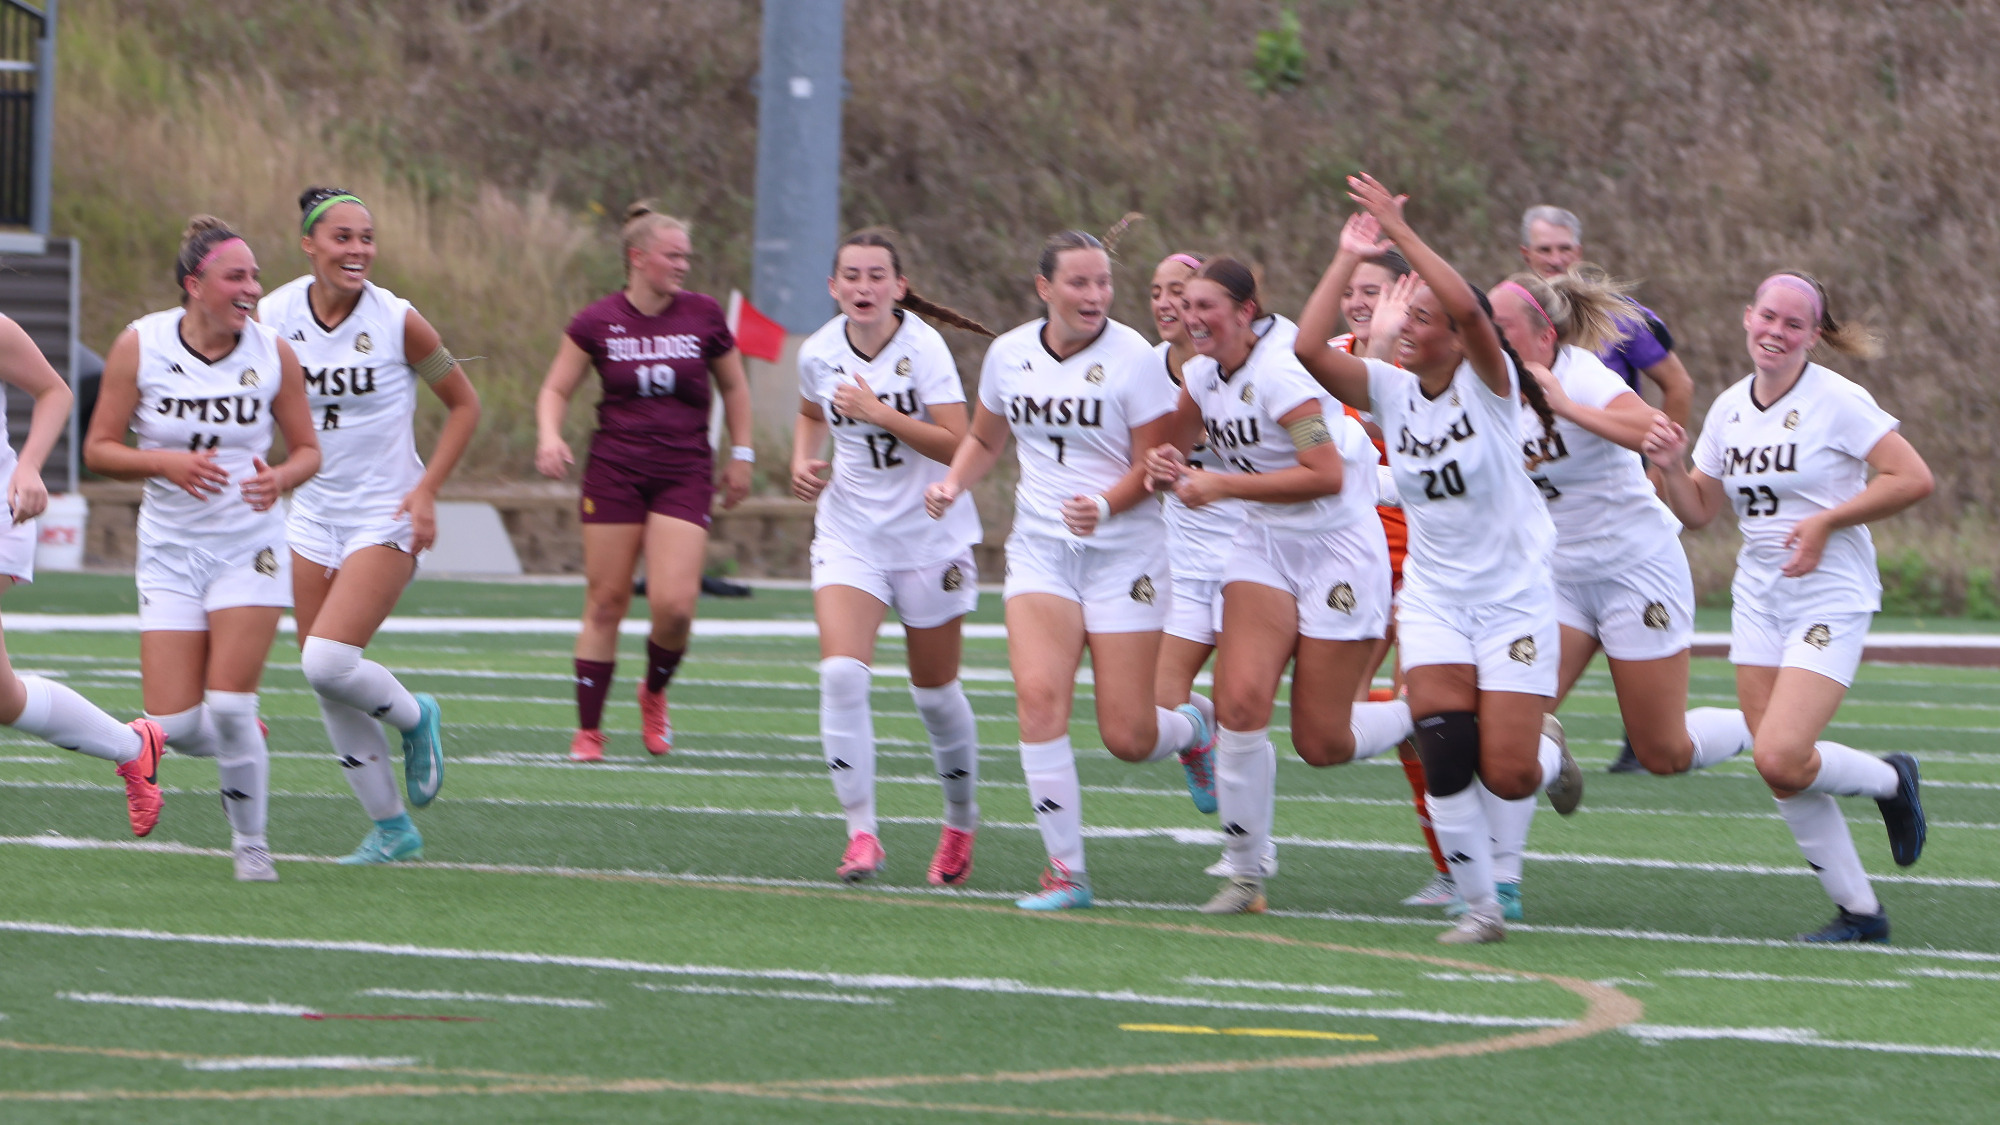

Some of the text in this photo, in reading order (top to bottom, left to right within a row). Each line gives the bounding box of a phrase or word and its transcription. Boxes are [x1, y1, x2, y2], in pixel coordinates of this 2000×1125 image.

[605, 334, 702, 361] BULLDOGS
[635, 364, 676, 397] 19
[157, 398, 260, 424] SMSU
[1010, 396, 1103, 428] SMSU
[866, 432, 904, 469] 12
[1047, 433, 1066, 466] 7
[1420, 460, 1466, 500] 20
[1738, 486, 1779, 516] 23
